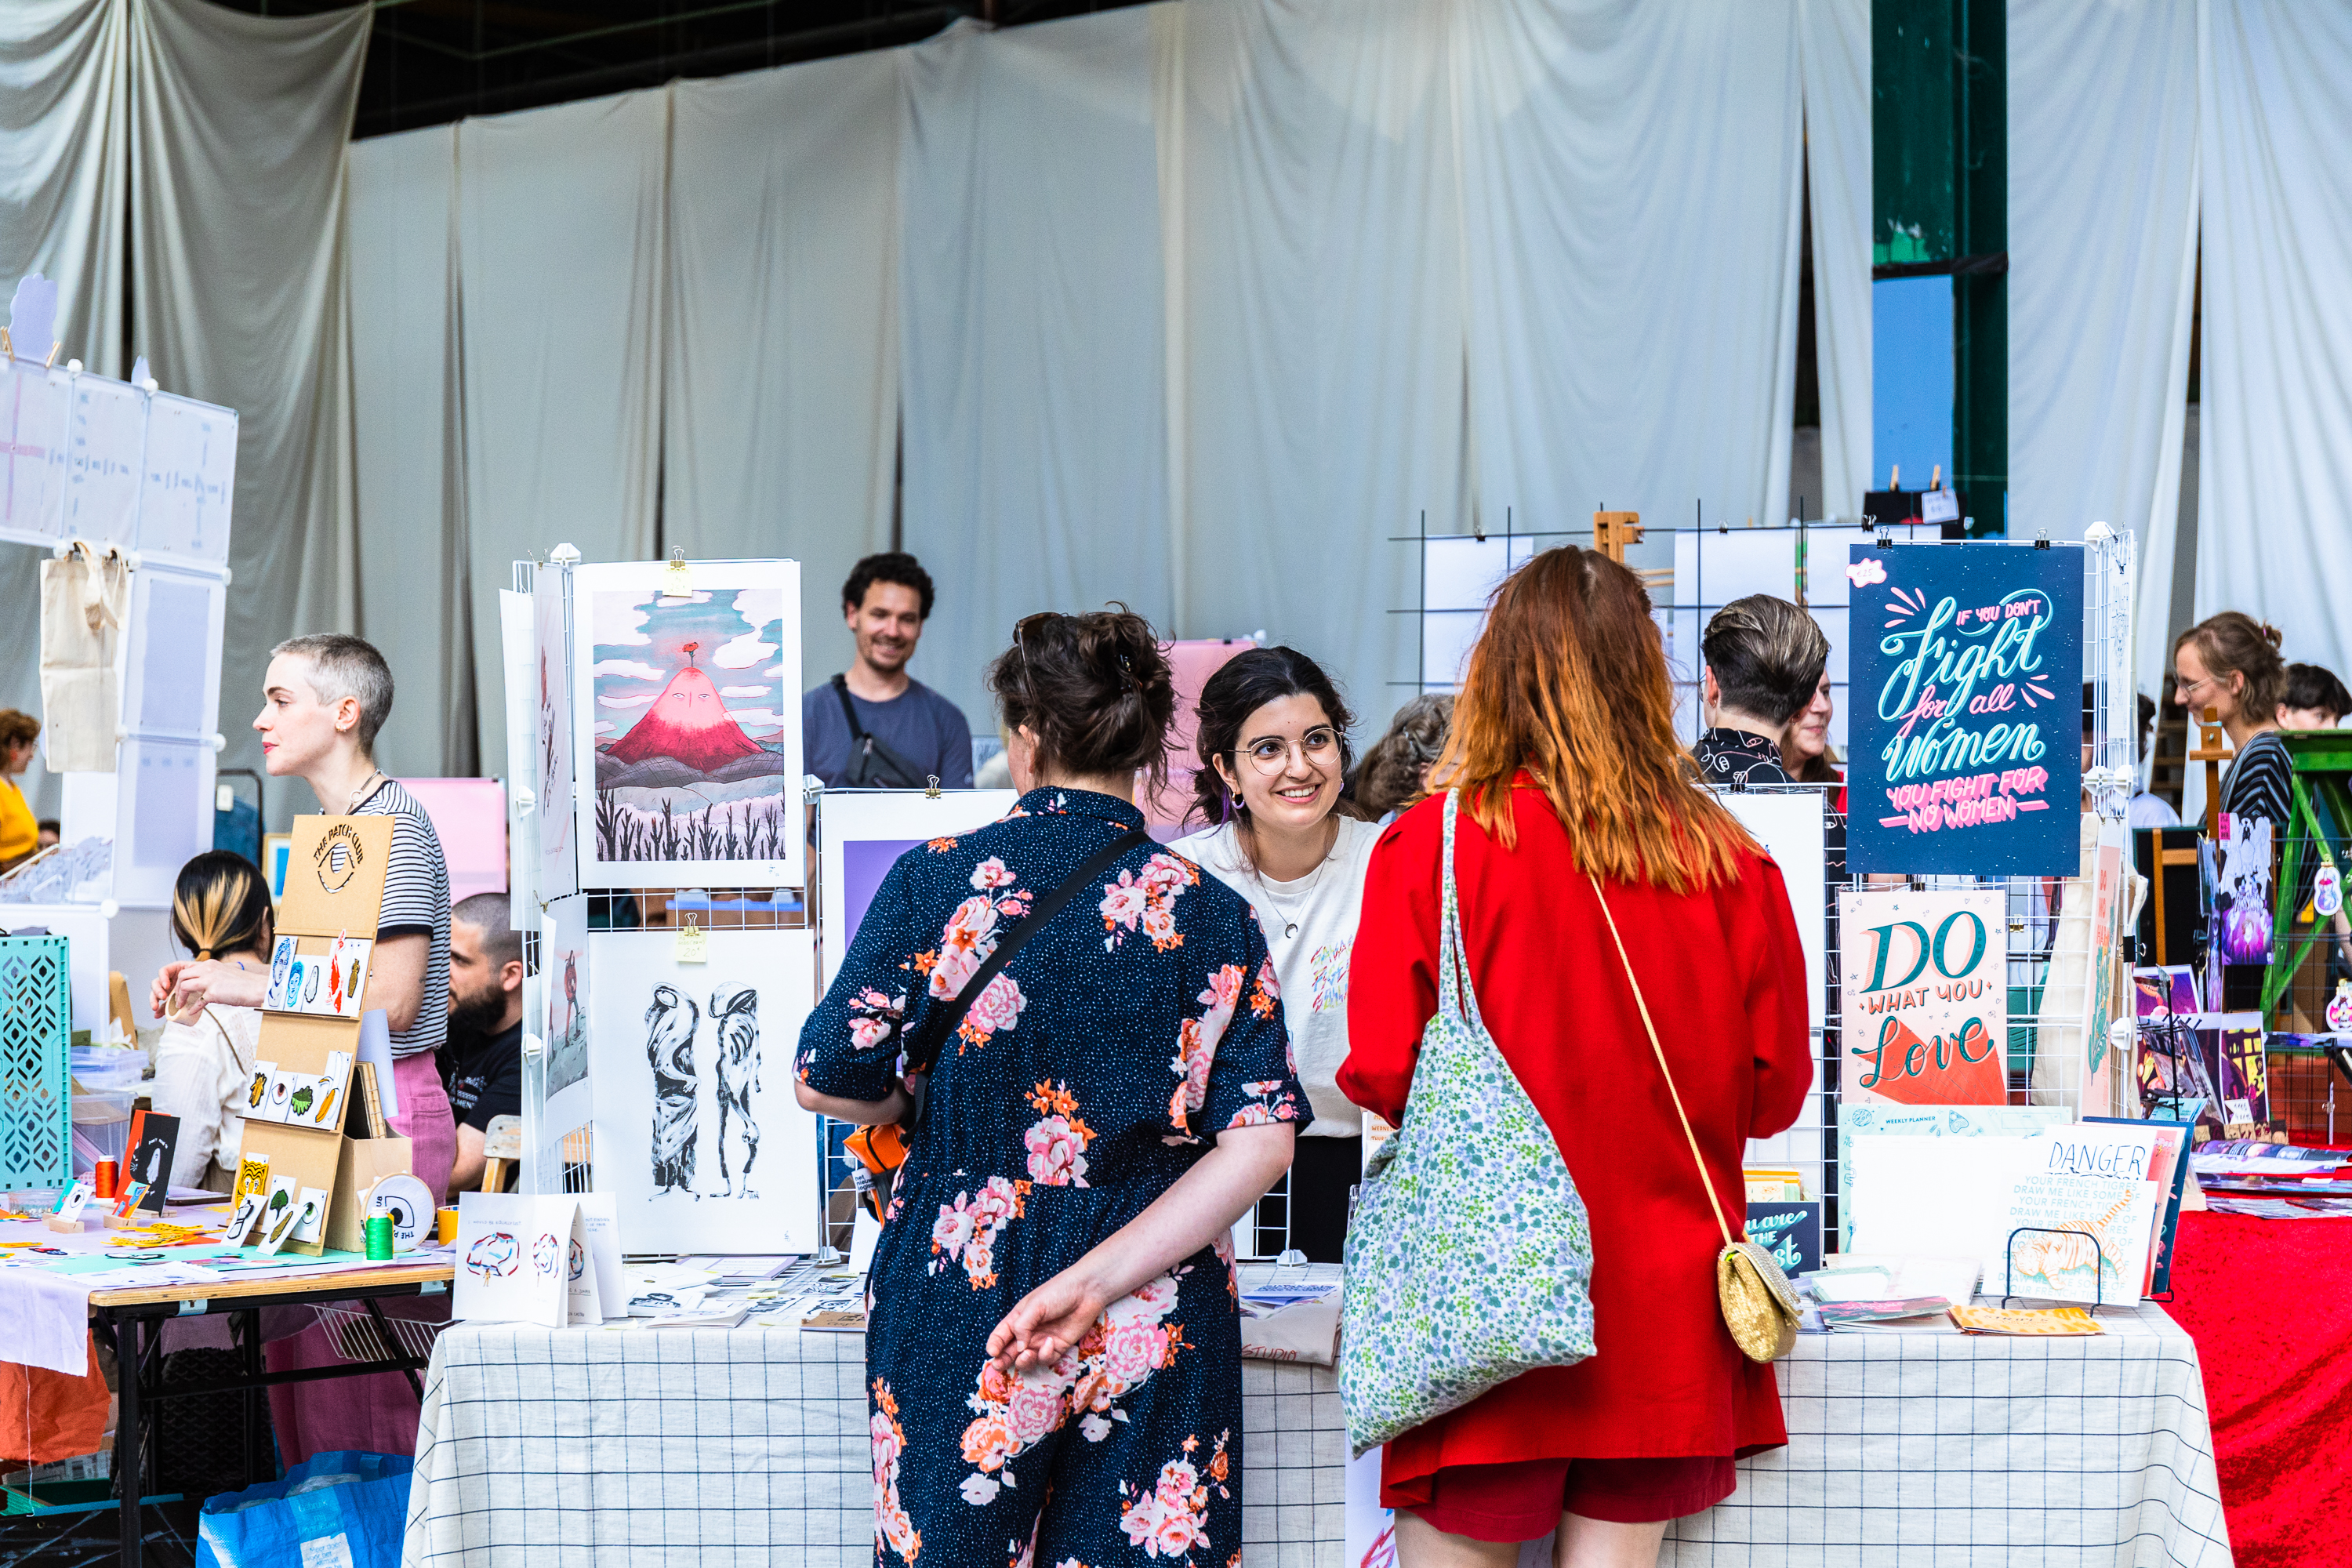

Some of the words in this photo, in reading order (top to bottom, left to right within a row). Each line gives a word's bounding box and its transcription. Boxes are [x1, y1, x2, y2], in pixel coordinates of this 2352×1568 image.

[1857, 568, 1872, 577] €25
[1956, 609, 1973, 626] IF
[1976, 605, 2000, 622] YOU
[2005, 599, 2041, 619] DON'T
[1969, 683, 2016, 715] all
[1886, 782, 1933, 811] YOU
[1929, 773, 2000, 804] FIGHT
[1998, 765, 2049, 797] FOR
[1908, 804, 1944, 834] NO
[1944, 795, 2016, 829] WOMEN
[313, 836, 328, 861] THE
[328, 823, 352, 841] PATCH
[351, 833, 364, 864] CLUB
[1859, 911, 1987, 994] DO
[1867, 986, 1929, 1014] WHAT
[1935, 978, 1983, 1002] YOU
[1851, 1015, 1994, 1088] Love
[2049, 1142, 2146, 1175] DANGER
[2013, 1185, 2045, 1195] DRAW
[2048, 1187, 2063, 1196] ME
[2067, 1189, 2089, 1198] LIKE
[2092, 1190, 2122, 1200] SOME
[2025, 1176, 2053, 1185] YOUR
[2056, 1178, 2098, 1189] FRENCH
[2103, 1180, 2137, 1192] TIGRES
[2019, 1196, 2047, 1207] YOUR
[2051, 1199, 2092, 1210] FRENCH
[1763, 1210, 1808, 1229] are
[2009, 1207, 2041, 1216] DRAW
[2044, 1209, 2060, 1218] ME
[2063, 1210, 2085, 1221] LIKE
[2089, 1212, 2118, 1223] SOE
[2122, 1214, 2137, 1224] OF
[2016, 1218, 2044, 1229] YOUR
[1748, 1230, 1778, 1244] THE
[2119, 1238, 2134, 1247] OF
[2003, 1283, 2031, 1294] YOUR
[2035, 1287, 2078, 1298] FRENCH
[2111, 1282, 2126, 1291] OF
[1242, 1343, 1298, 1361] STUDIO
